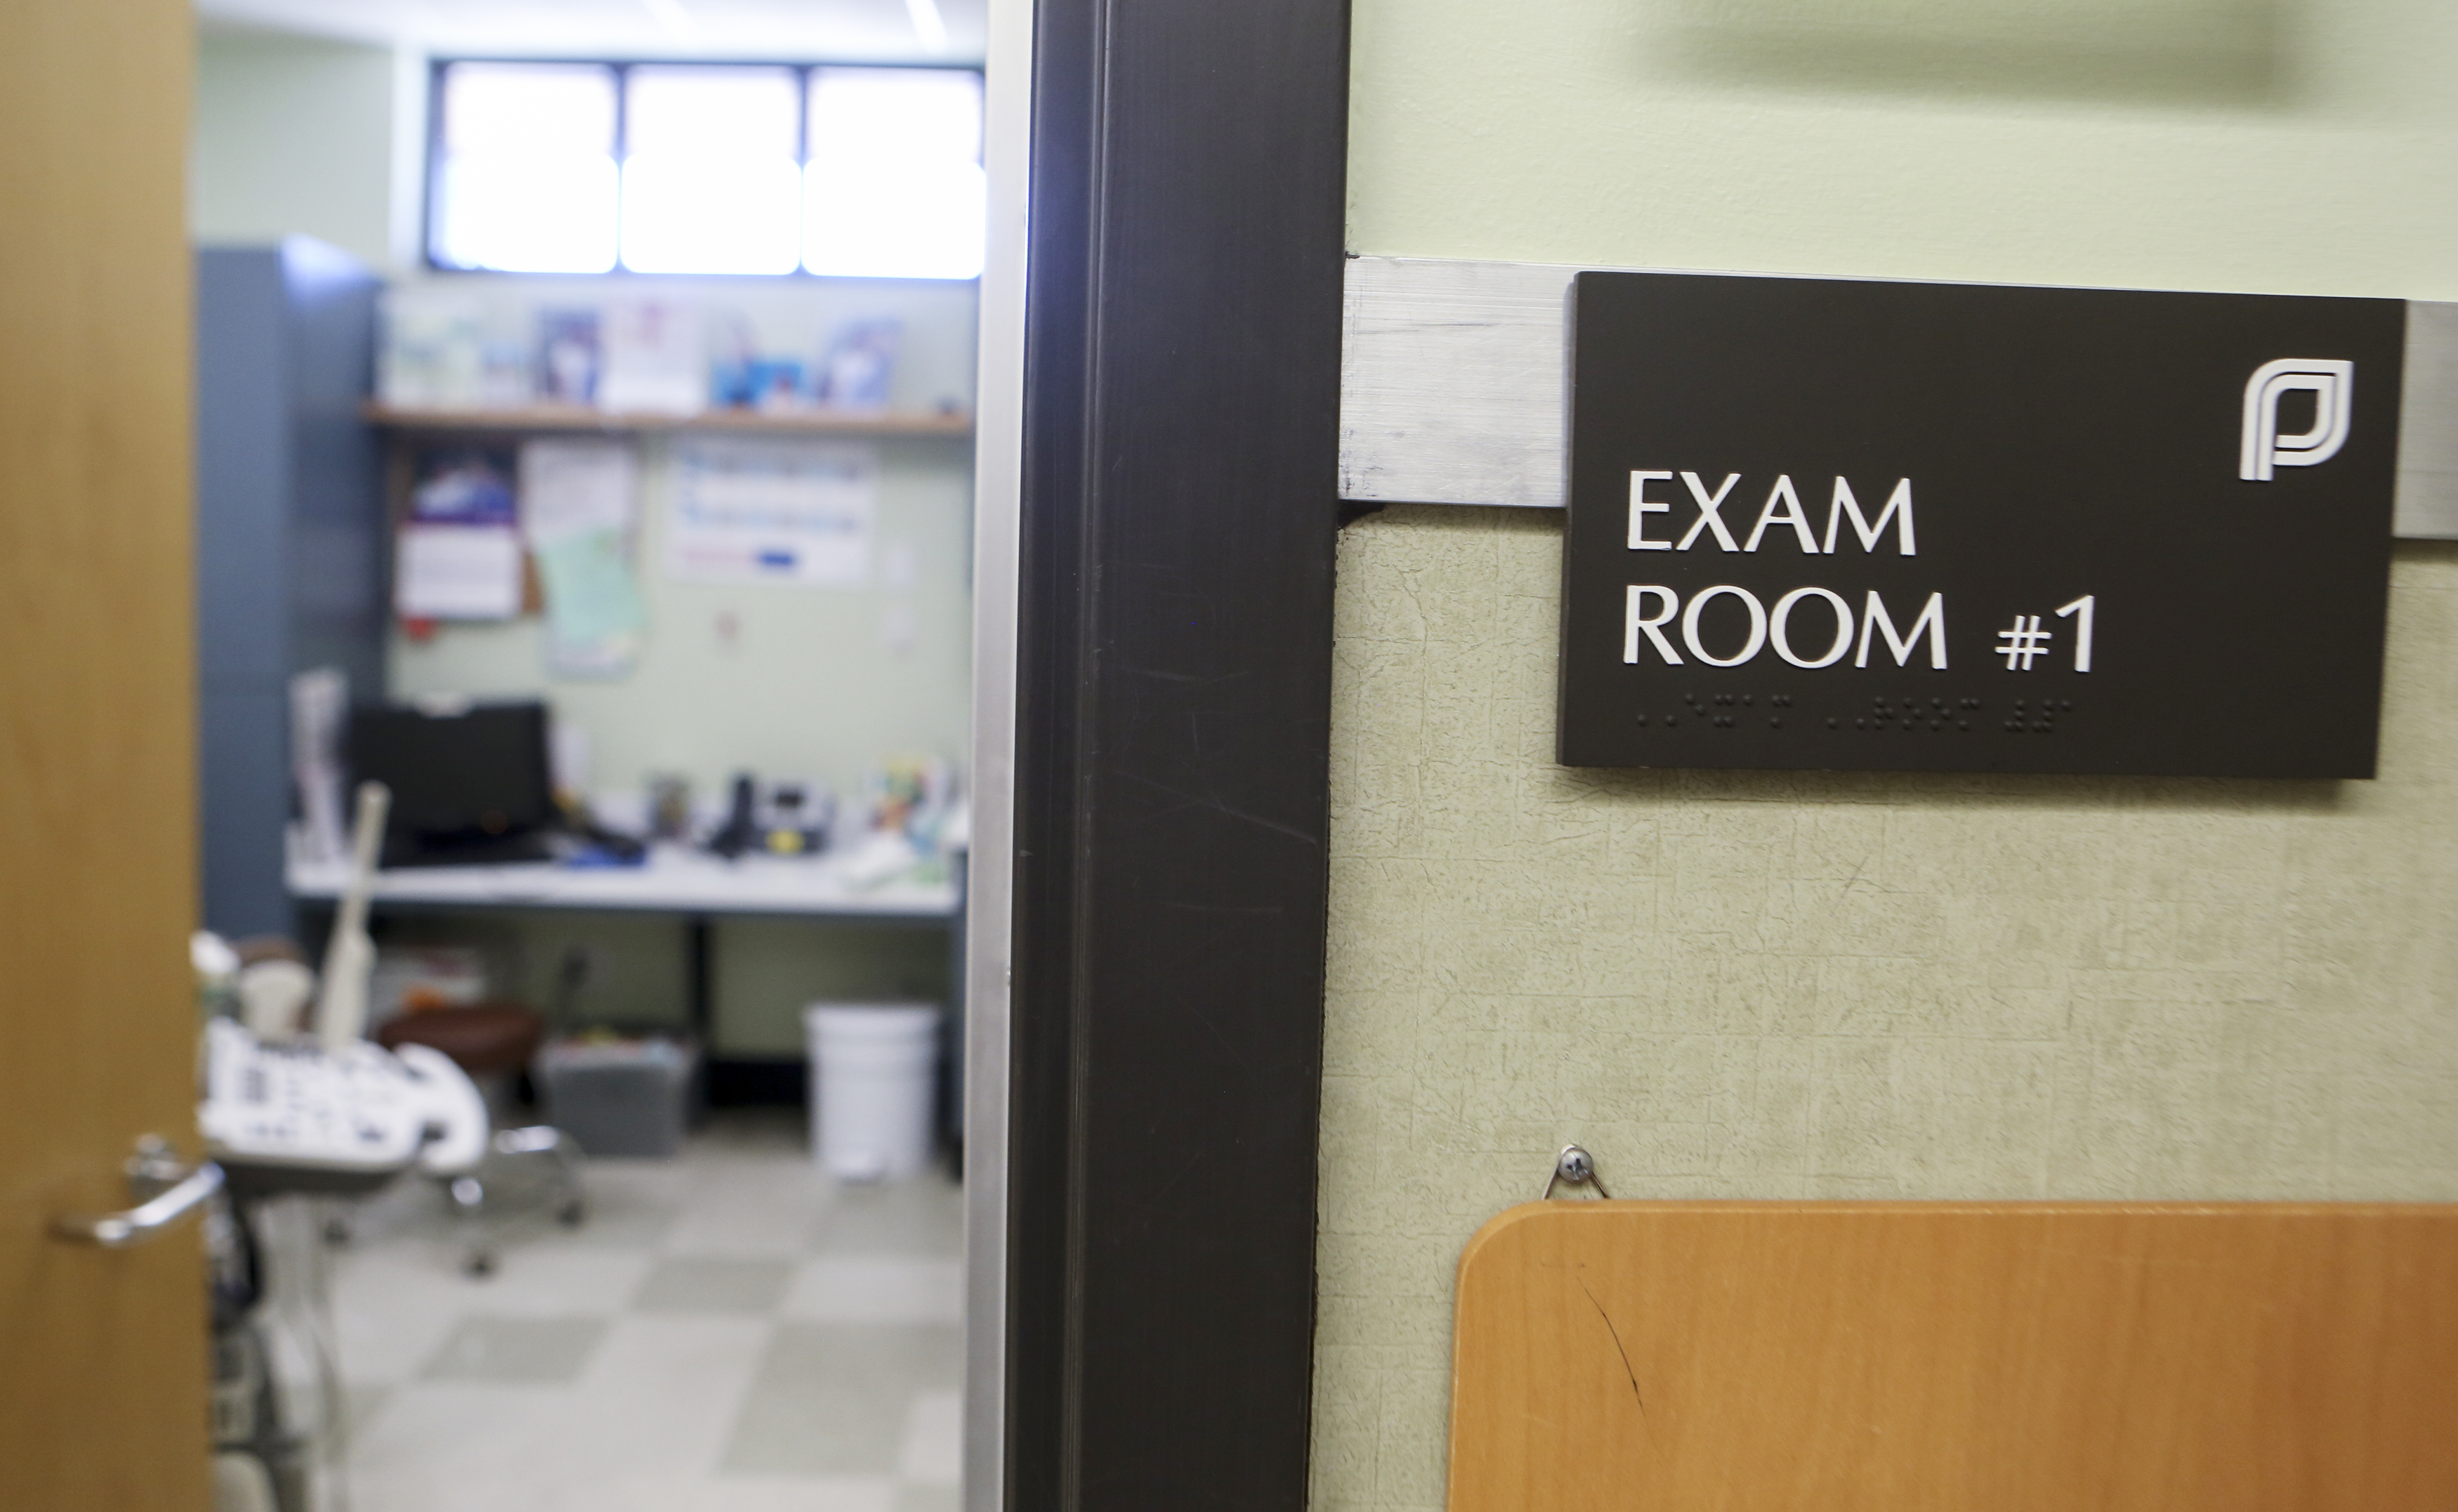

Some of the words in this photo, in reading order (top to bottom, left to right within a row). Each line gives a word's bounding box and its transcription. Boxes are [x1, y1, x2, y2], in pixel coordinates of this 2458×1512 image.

[1628, 471, 1916, 556] EXAM
[1624, 585, 1947, 669] ROOM
[1995, 596, 2094, 673] #1
